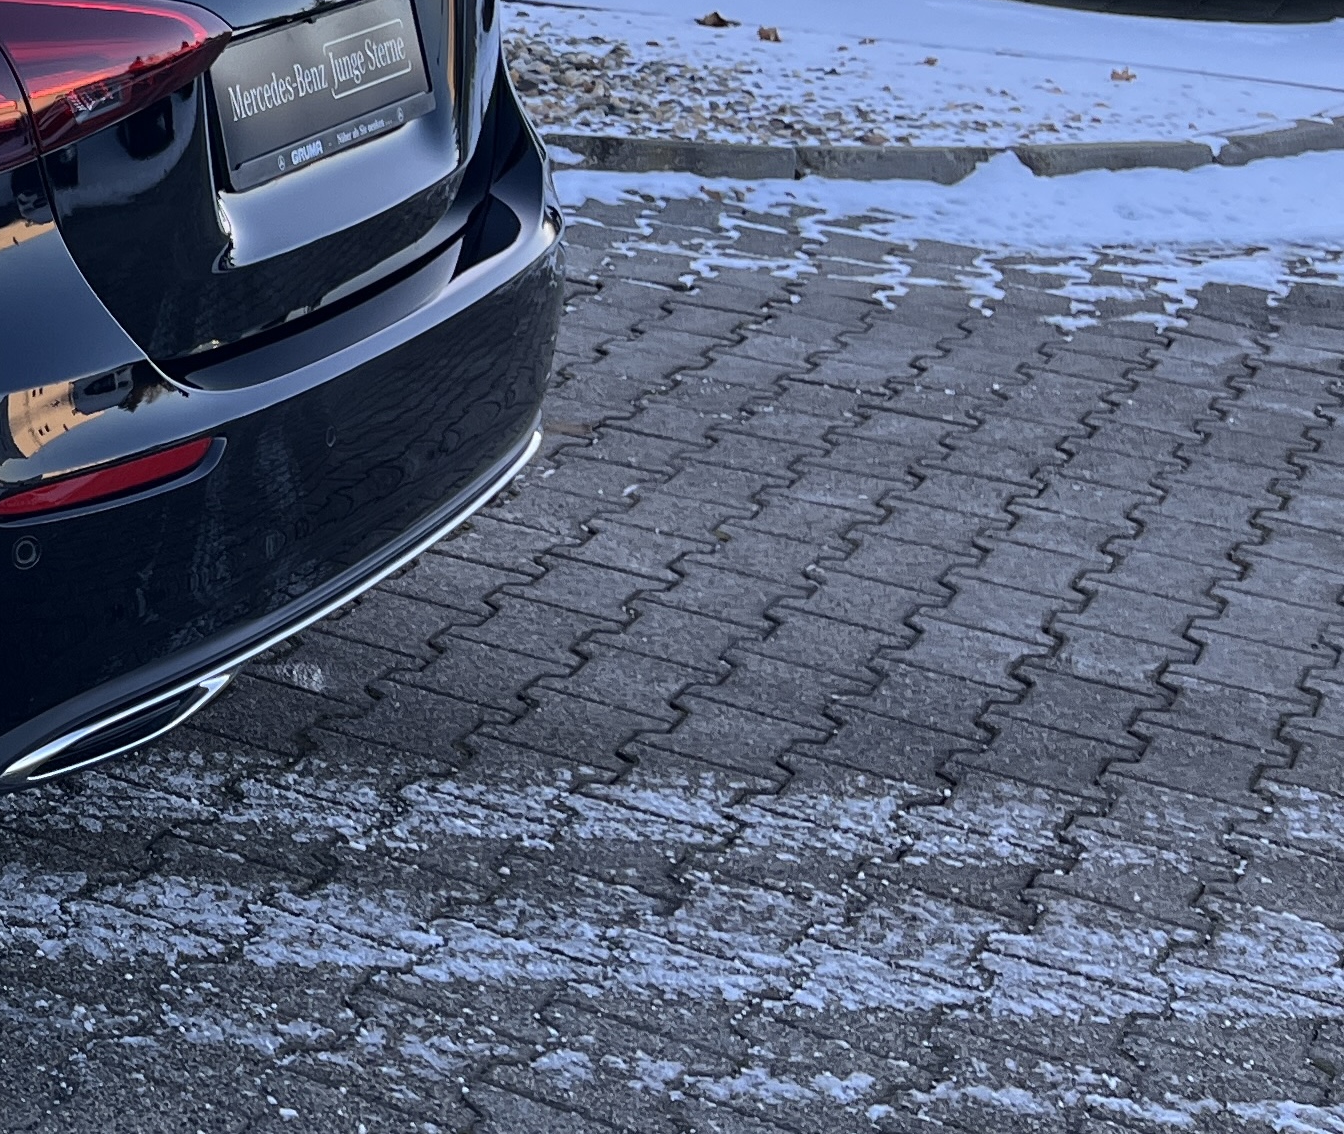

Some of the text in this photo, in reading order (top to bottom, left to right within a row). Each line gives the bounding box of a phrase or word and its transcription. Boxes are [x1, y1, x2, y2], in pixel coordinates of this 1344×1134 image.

[228, 36, 406, 122] Mercedes-Benz Junge Sterne
